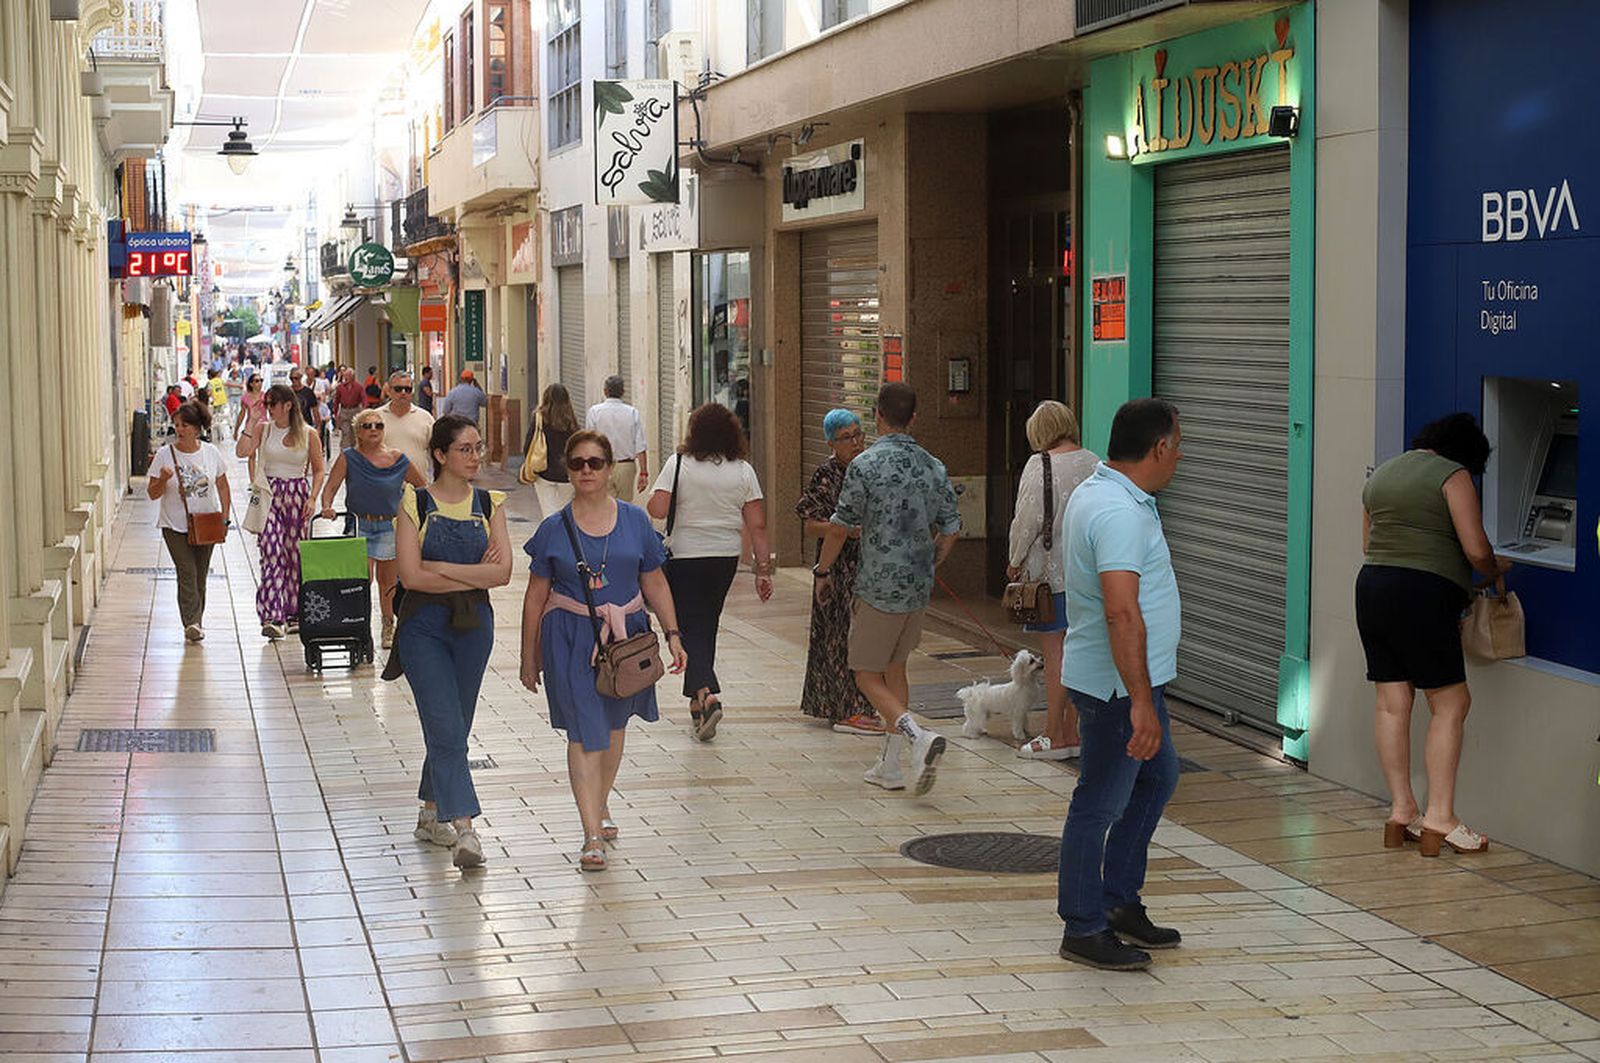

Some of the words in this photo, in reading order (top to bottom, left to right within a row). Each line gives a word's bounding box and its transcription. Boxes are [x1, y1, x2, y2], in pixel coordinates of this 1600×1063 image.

[1482, 179, 1580, 242] BBVA
[1481, 280, 1495, 301] Tu
[1497, 280, 1539, 301] Oficina
[1480, 310, 1517, 335] Digital
